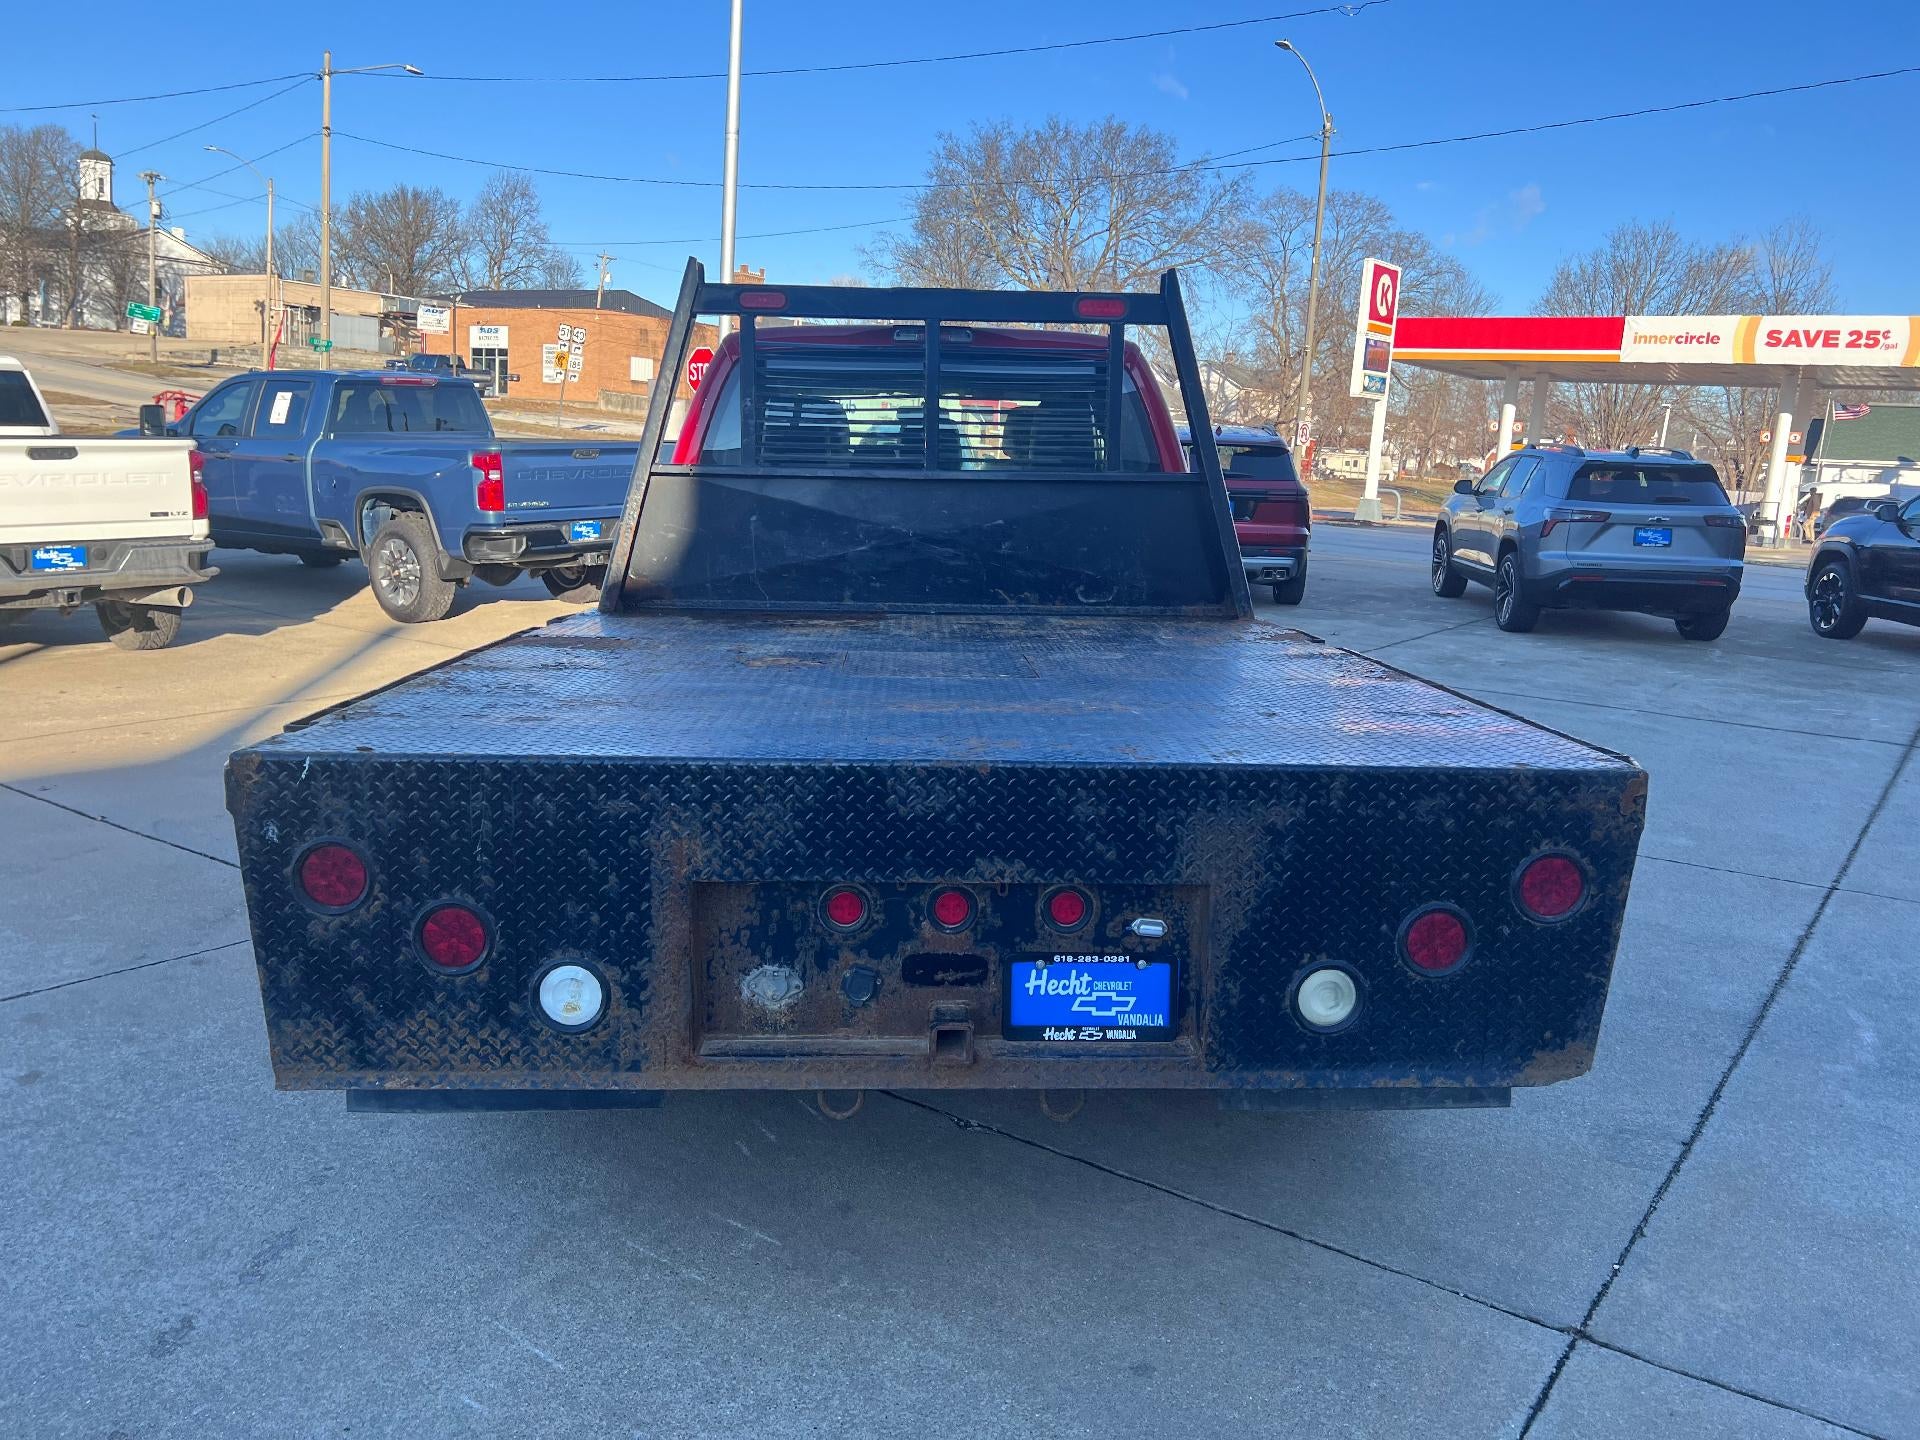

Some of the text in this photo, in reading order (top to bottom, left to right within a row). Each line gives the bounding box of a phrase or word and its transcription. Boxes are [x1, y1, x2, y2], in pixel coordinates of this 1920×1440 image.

[560, 327, 570, 336] 51
[573, 330, 585, 341] 40
[1764, 329, 1841, 348] SAVE
[1632, 332, 1721, 346] innercircle
[689, 362, 710, 381] ST
[1025, 968, 1133, 996] Hecht CHEVROLET
[1117, 1013, 1164, 1027] VANDALIA
[1042, 1026, 1137, 1041] Hecht VANDALIA
